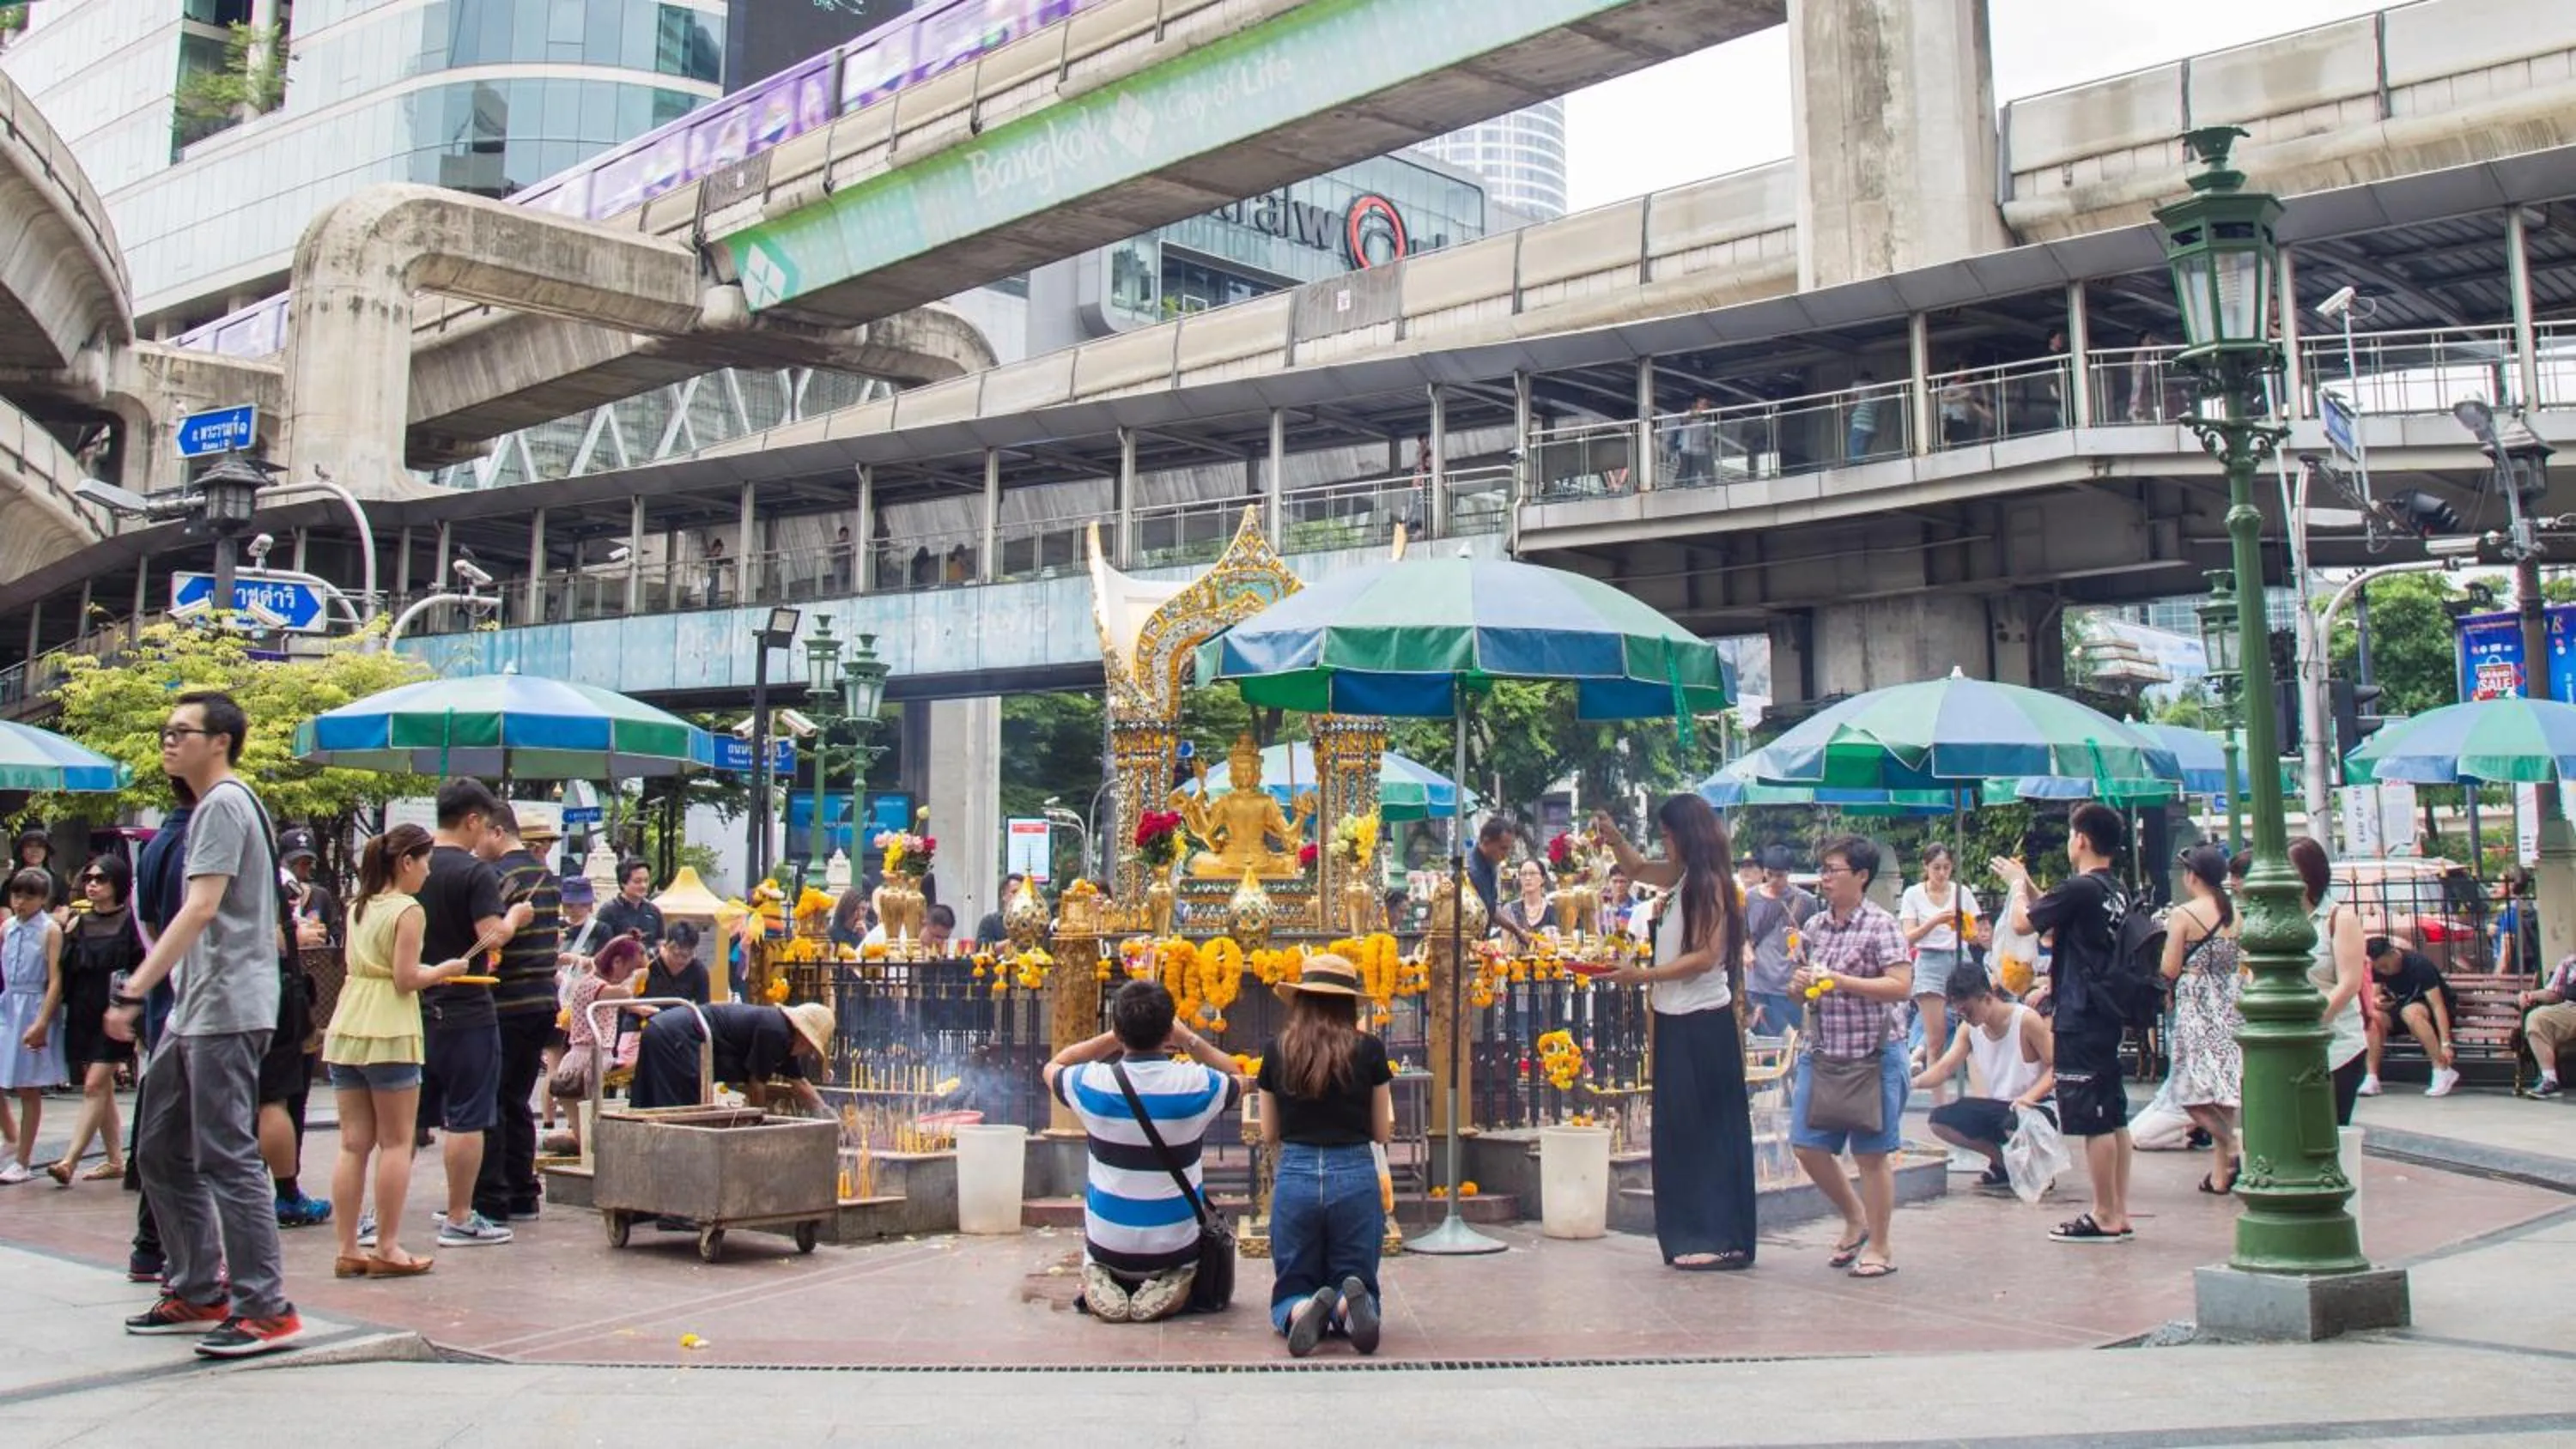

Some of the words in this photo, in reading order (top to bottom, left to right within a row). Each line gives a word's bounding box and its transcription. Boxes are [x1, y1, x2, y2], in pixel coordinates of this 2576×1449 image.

[965, 106, 1109, 197] Bangkok
[1214, 65, 1236, 107] of
[1241, 51, 1293, 96] Life
[2480, 678, 2512, 690] SALE
